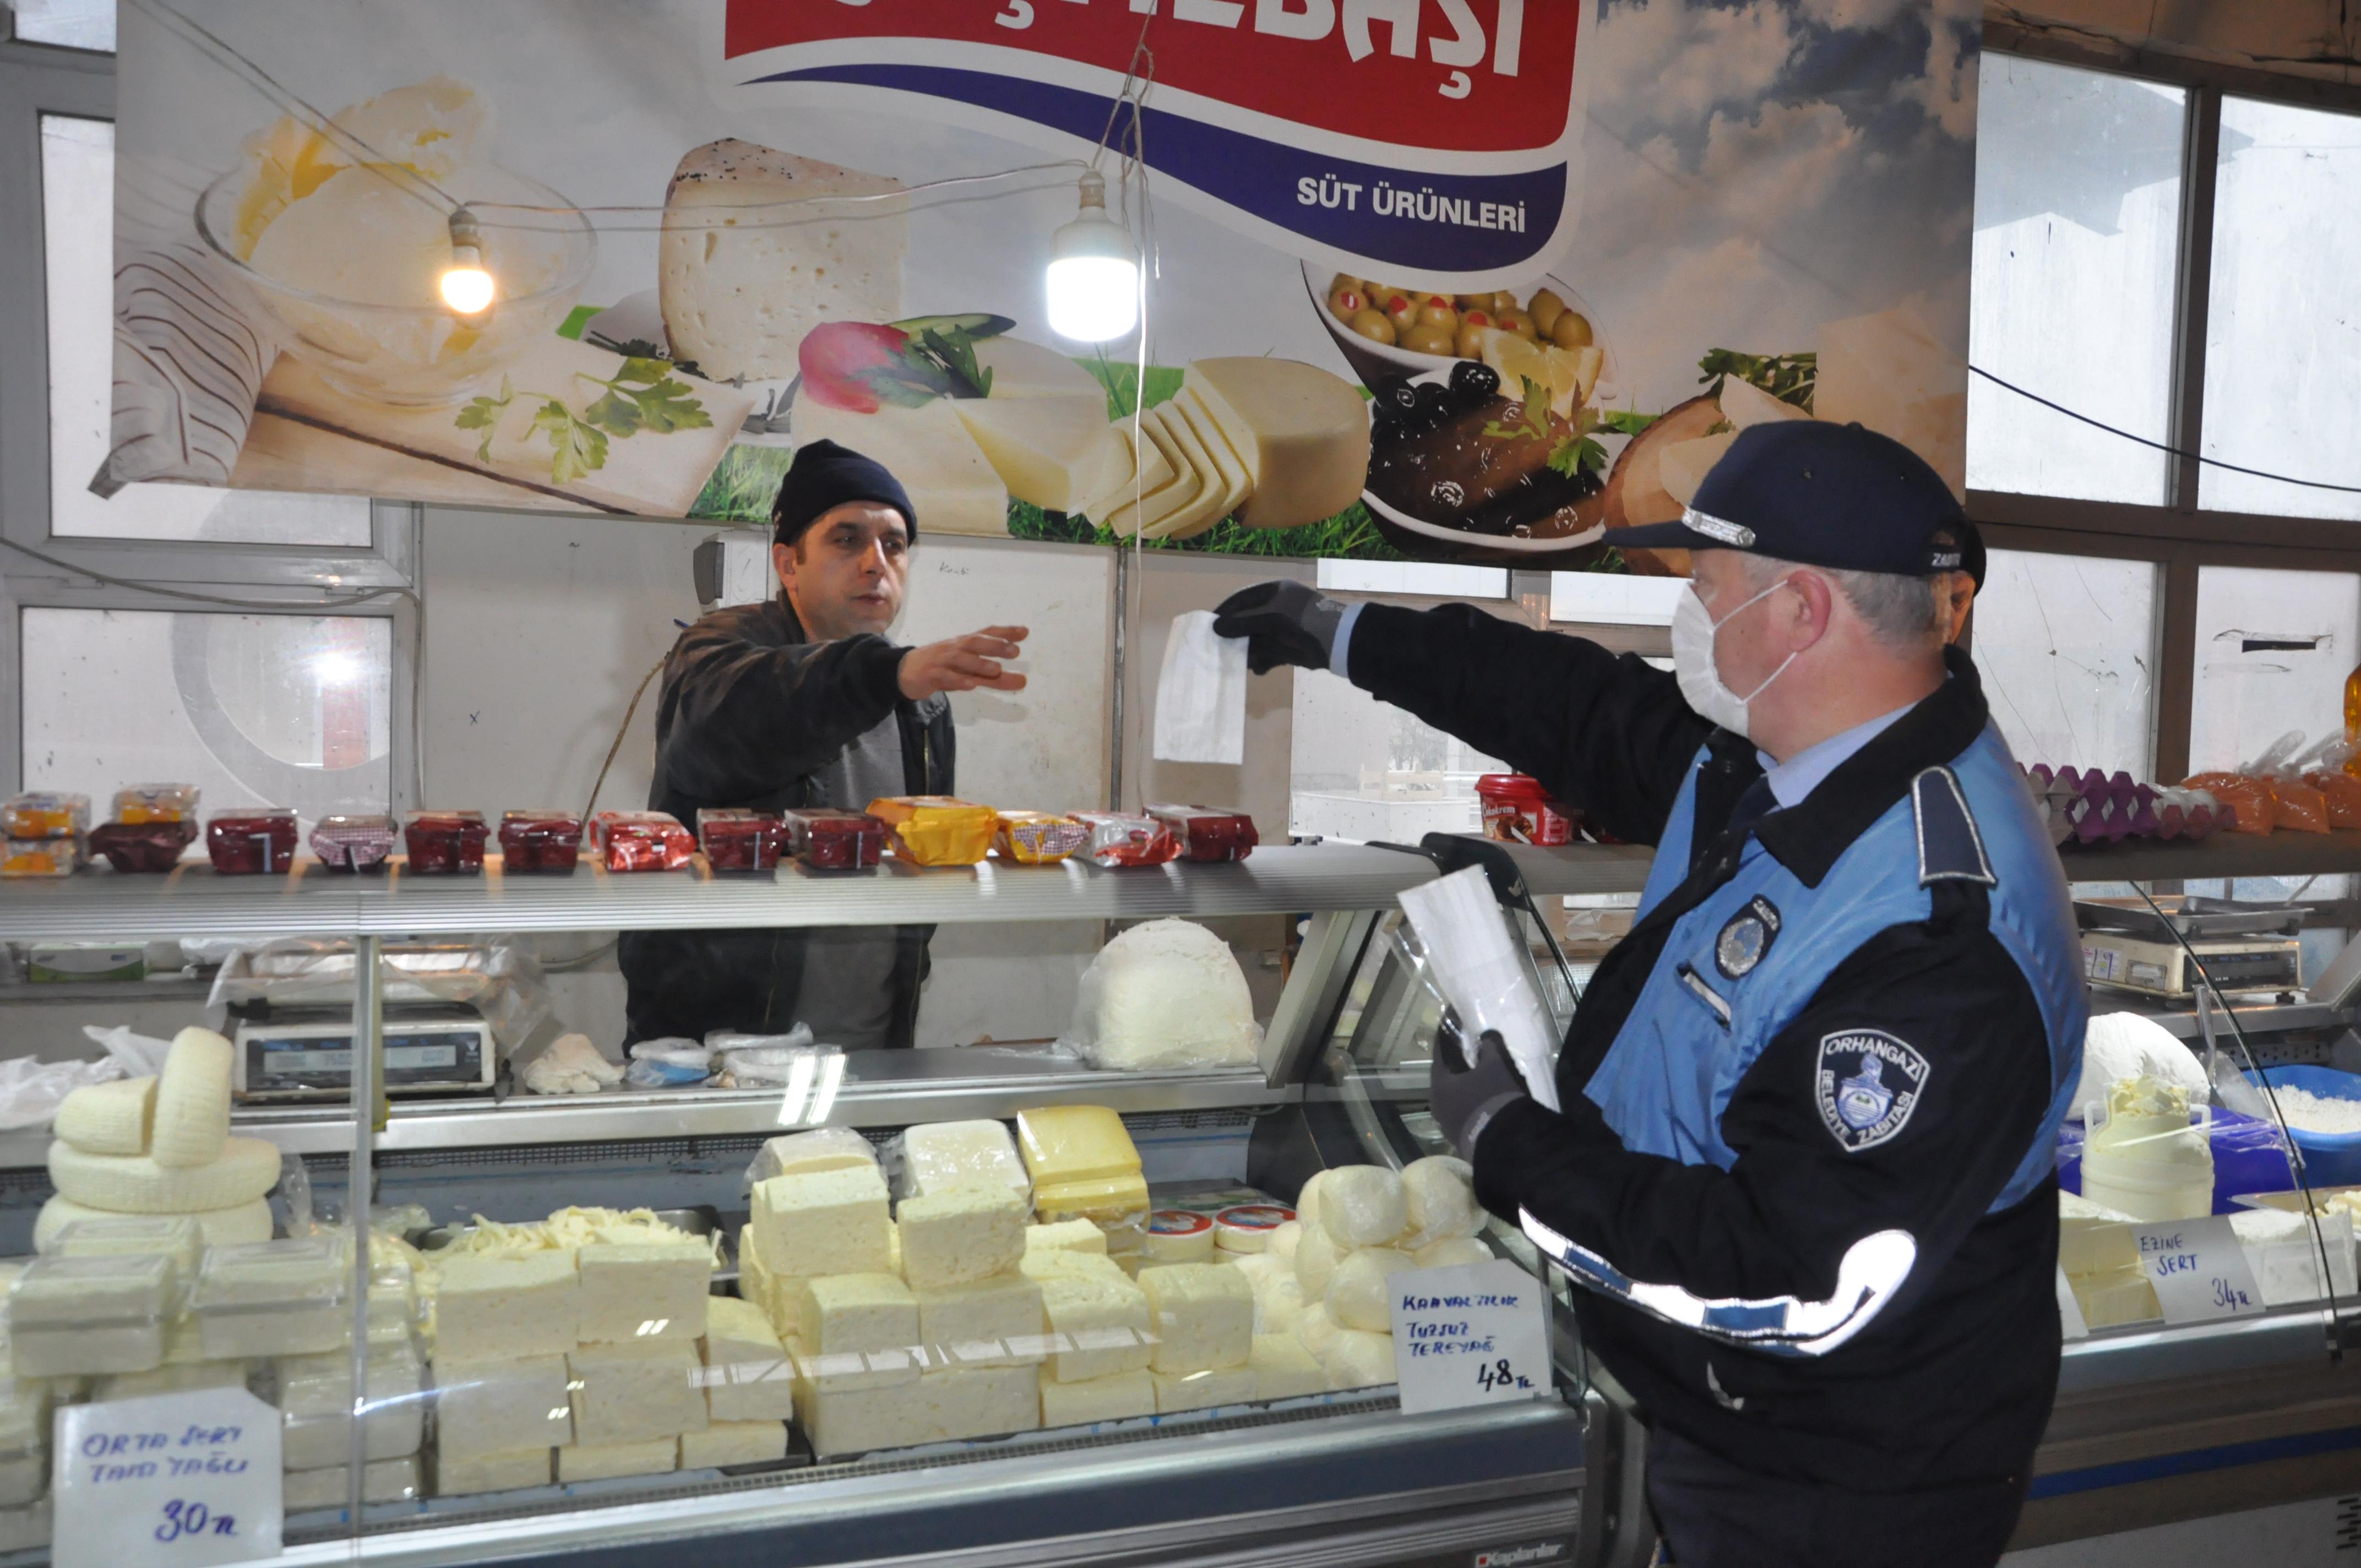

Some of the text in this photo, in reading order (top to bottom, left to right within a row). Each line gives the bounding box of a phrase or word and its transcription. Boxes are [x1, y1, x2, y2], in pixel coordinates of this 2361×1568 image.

[1297, 173, 1525, 233] SÜT ÜRÜNLERİ
[2156, 1254, 2197, 1276] SERT
[82, 1433, 168, 1457] ORTA
